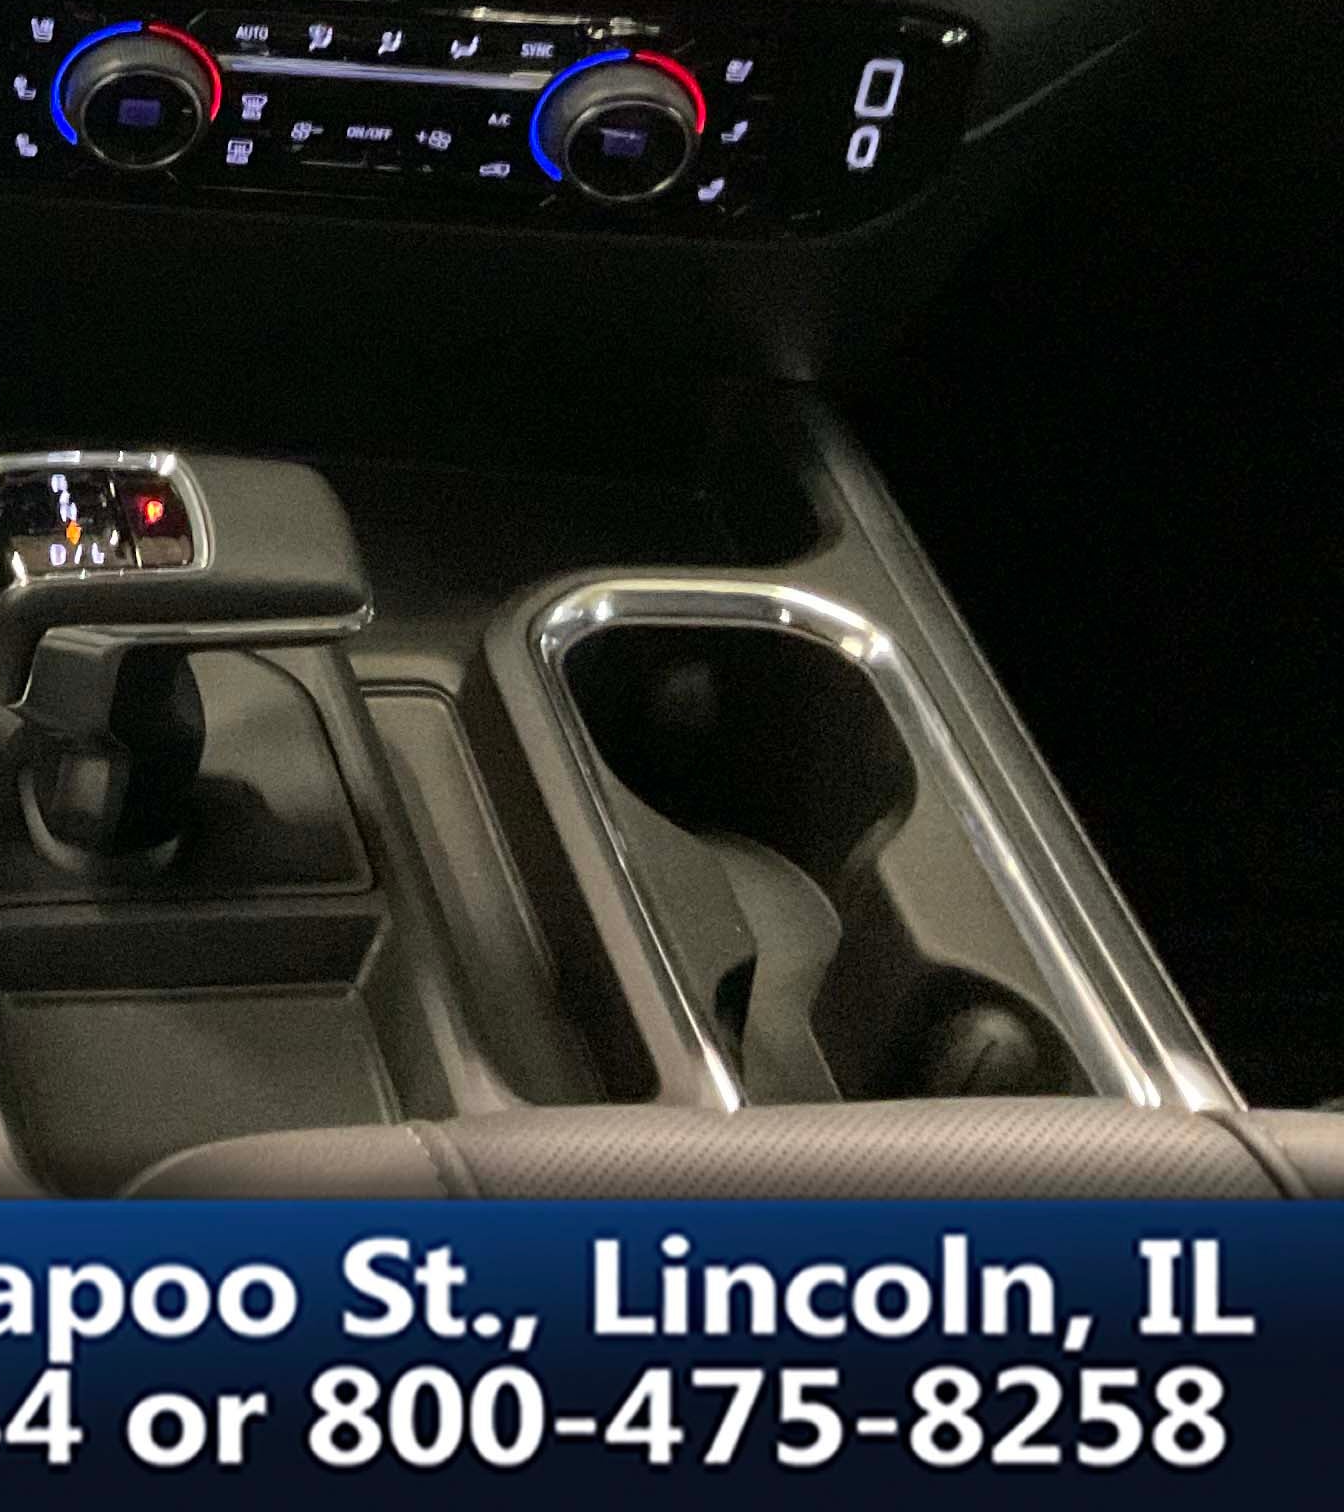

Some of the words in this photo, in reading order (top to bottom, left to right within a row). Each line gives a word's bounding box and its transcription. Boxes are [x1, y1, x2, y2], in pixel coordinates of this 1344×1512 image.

[235, 24, 269, 41] AUTO
[520, 41, 554, 59] SYNC
[346, 124, 393, 141] ON/OFF
